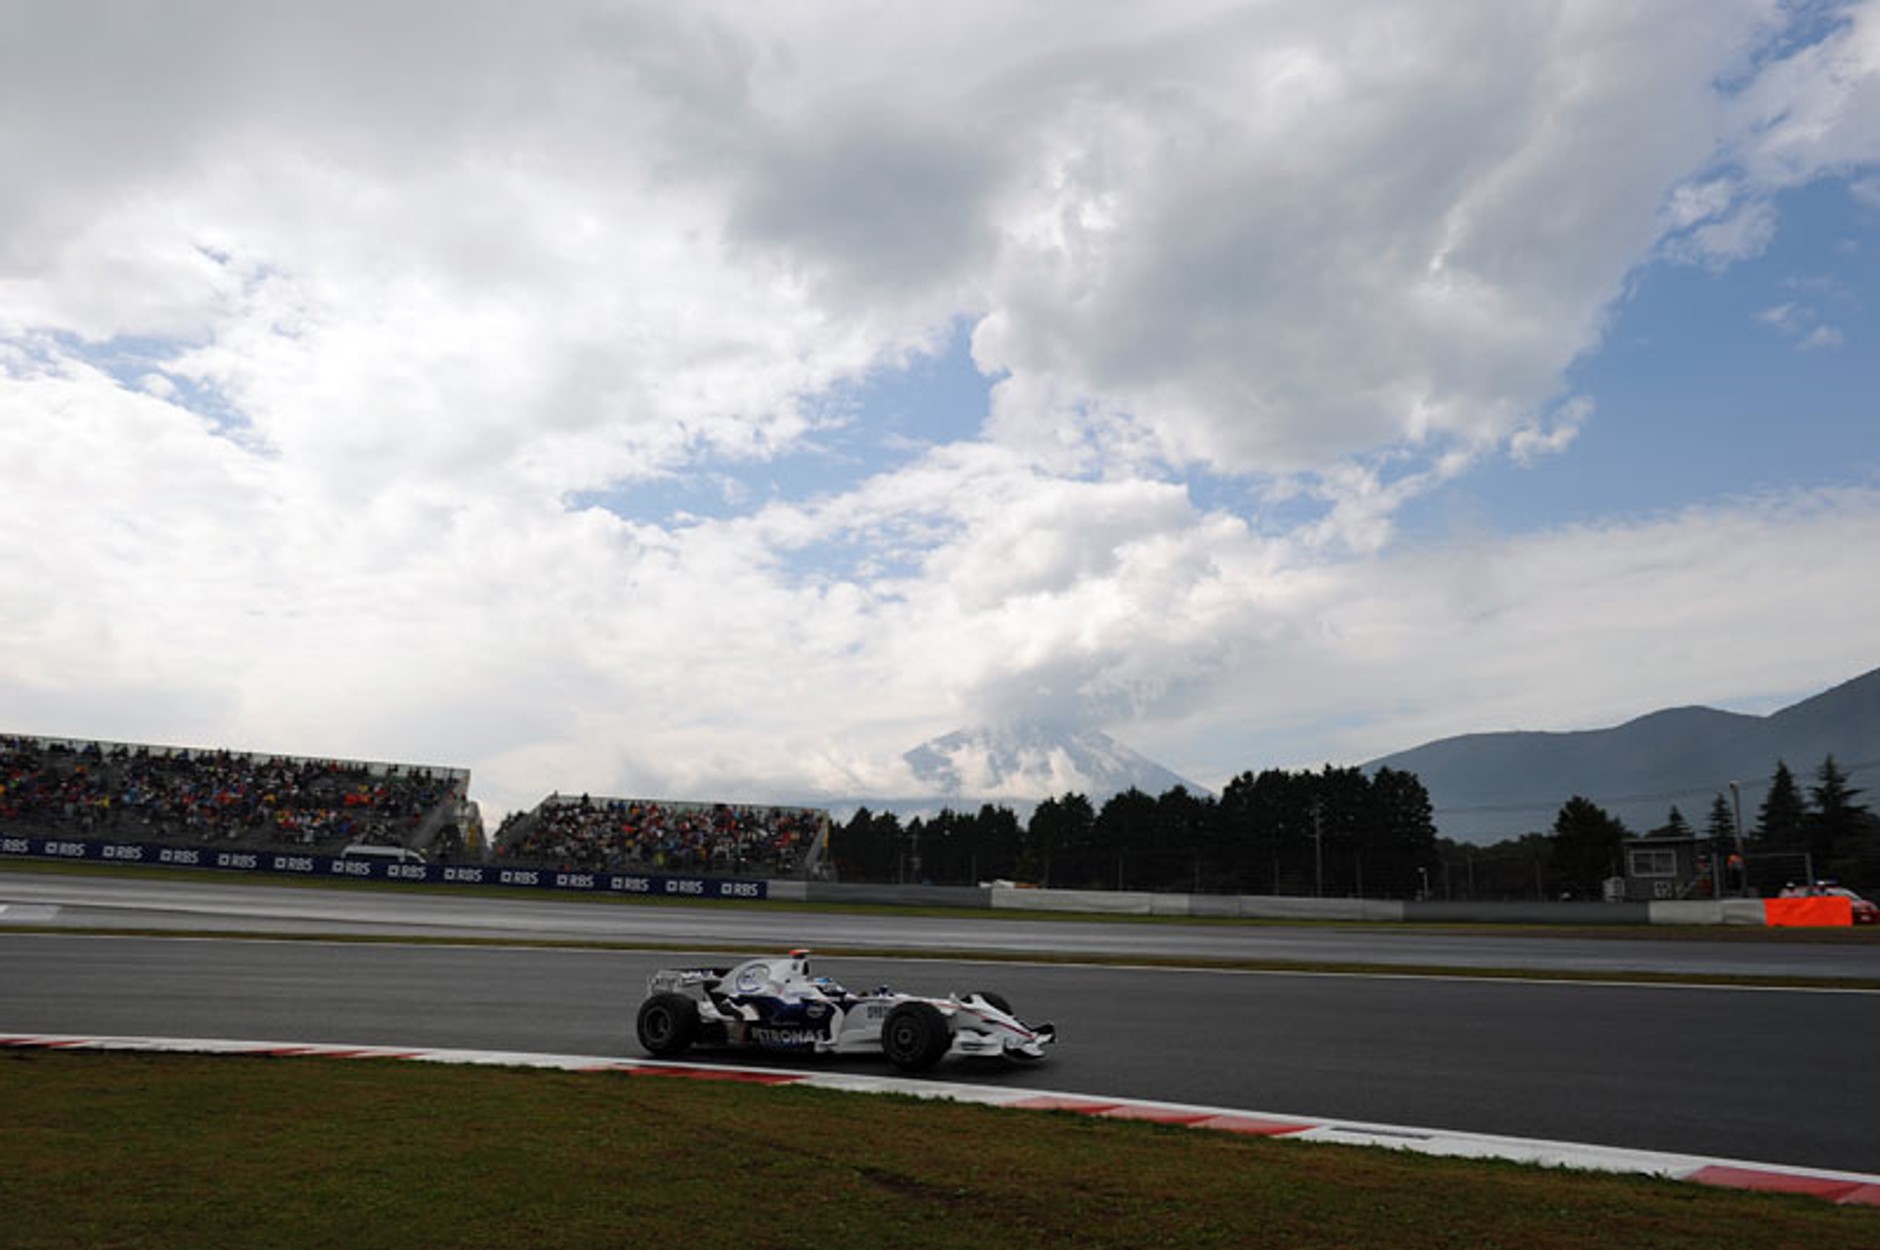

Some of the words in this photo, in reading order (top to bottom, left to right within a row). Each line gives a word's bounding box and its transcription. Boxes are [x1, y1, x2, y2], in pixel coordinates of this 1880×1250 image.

[3, 838, 29, 852] RBS
[58, 843, 86, 857] RBS
[115, 846, 142, 860] RBS
[174, 850, 199, 864] RBS
[231, 854, 257, 868] RBS
[288, 857, 314, 872] RBS
[345, 862, 371, 876] RBS
[401, 865, 427, 879] RBS
[458, 868, 483, 883] RBS
[514, 871, 539, 885] RBS
[569, 874, 594, 888] RBS
[624, 878, 649, 892] RBS
[679, 881, 704, 895] RBS
[733, 883, 758, 897] RBS
